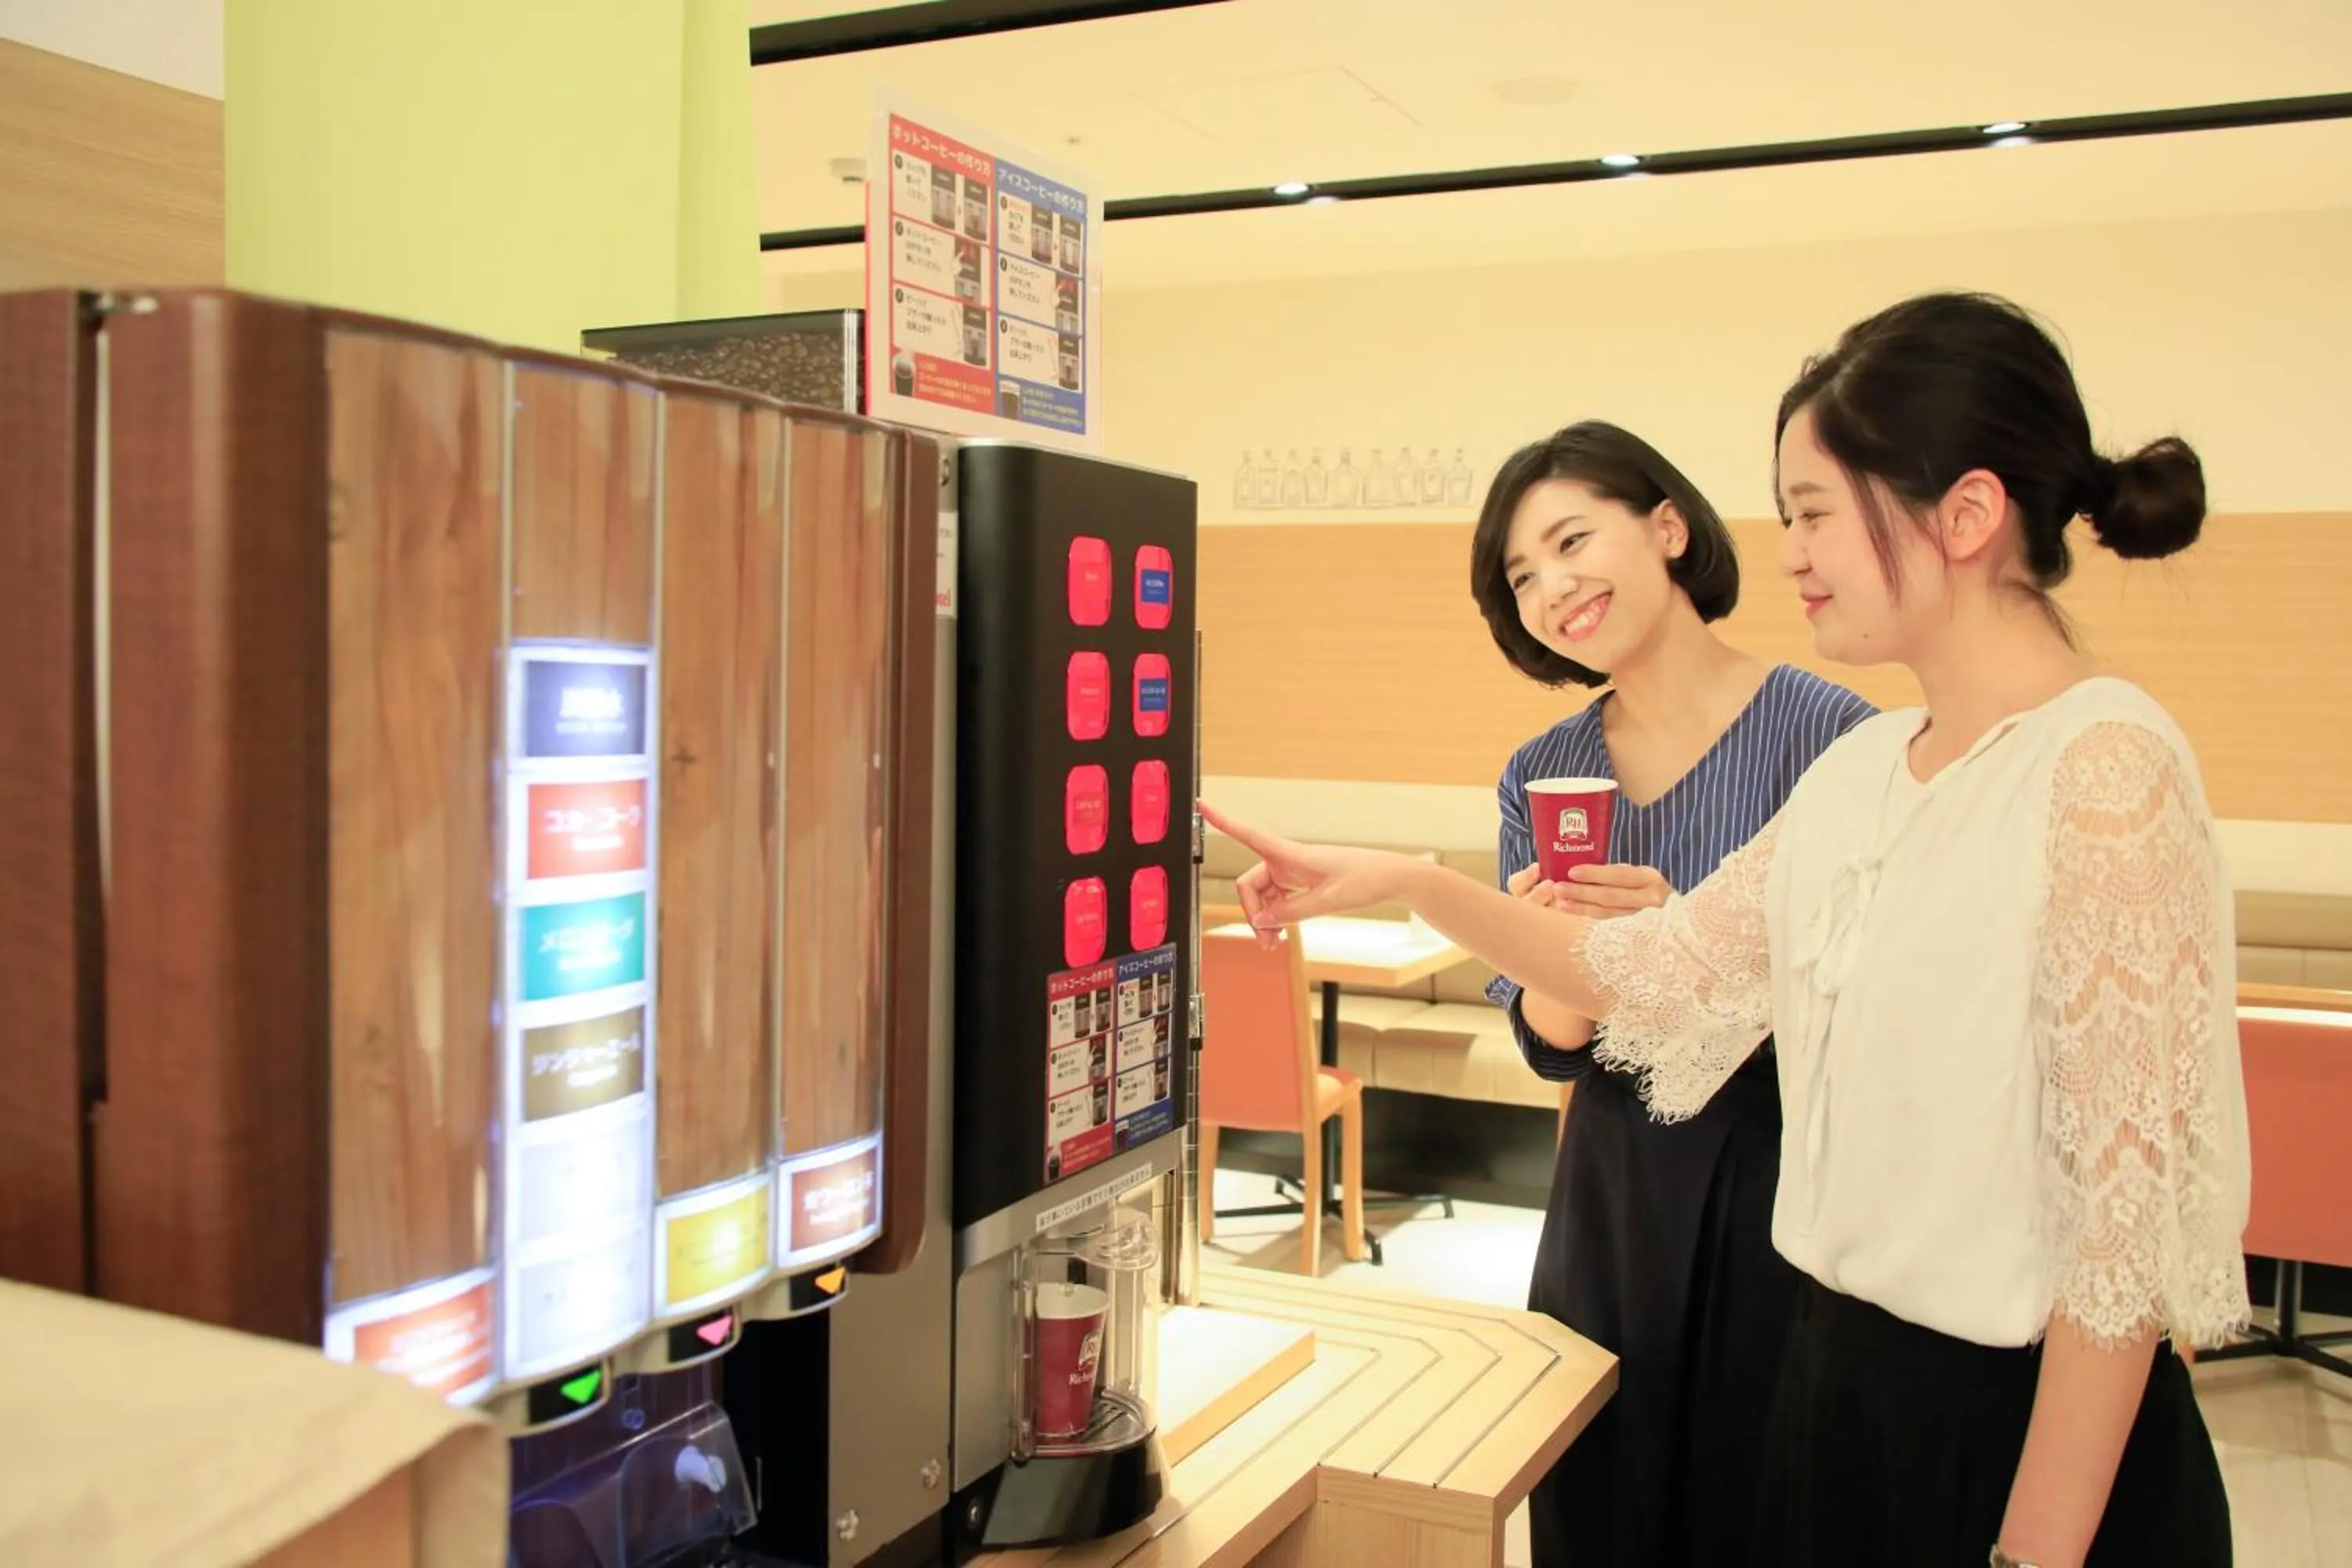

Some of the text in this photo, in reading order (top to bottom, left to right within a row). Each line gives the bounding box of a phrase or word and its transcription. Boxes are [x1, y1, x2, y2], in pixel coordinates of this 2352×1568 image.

[891, 123, 991, 177] ホットコーヒーの作り方
[999, 167, 1086, 214] アイスコーヒーの作り方
[1553, 840, 1594, 853] Richmond
[1118, 950, 1174, 976] アイスコーヒーの作り方
[1050, 967, 1114, 994] ホットコーヒーの作り方
